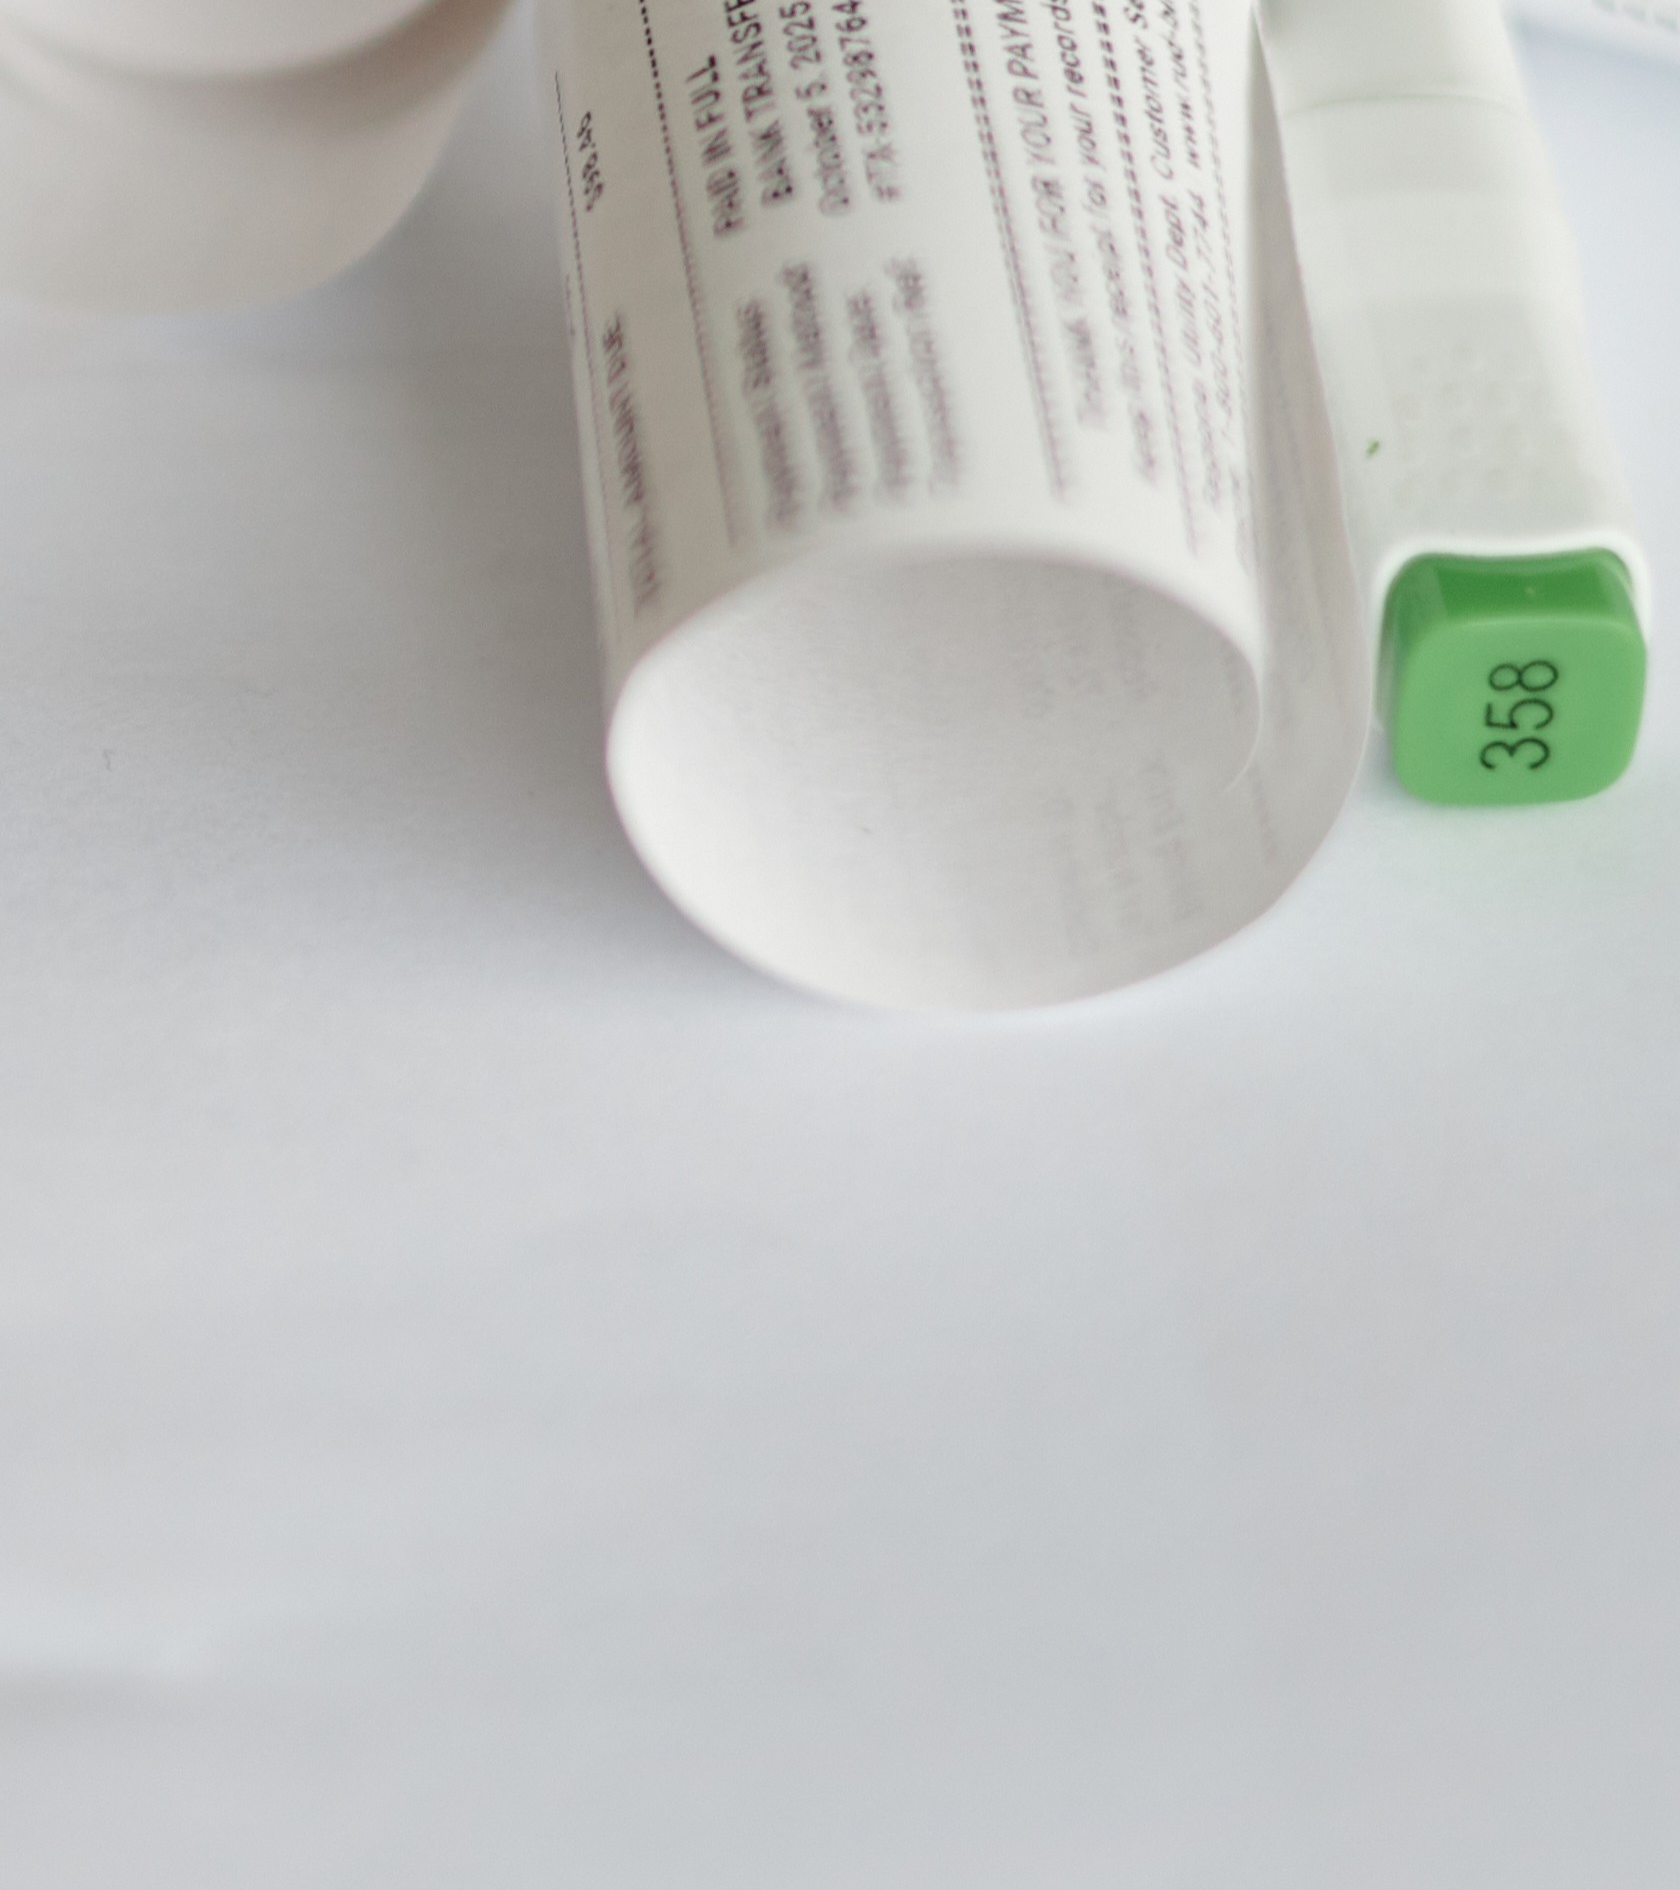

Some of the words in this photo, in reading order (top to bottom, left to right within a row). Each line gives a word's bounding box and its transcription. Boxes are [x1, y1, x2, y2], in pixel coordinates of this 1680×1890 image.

[777, 0, 823, 74] 2025
[685, 53, 723, 132] FULL
[1018, 84, 1059, 174] YOUR
[1127, 41, 1177, 181] Customer
[750, 118, 797, 210] BANK
[1073, 96, 1105, 184] your
[1478, 655, 1561, 777] 358
